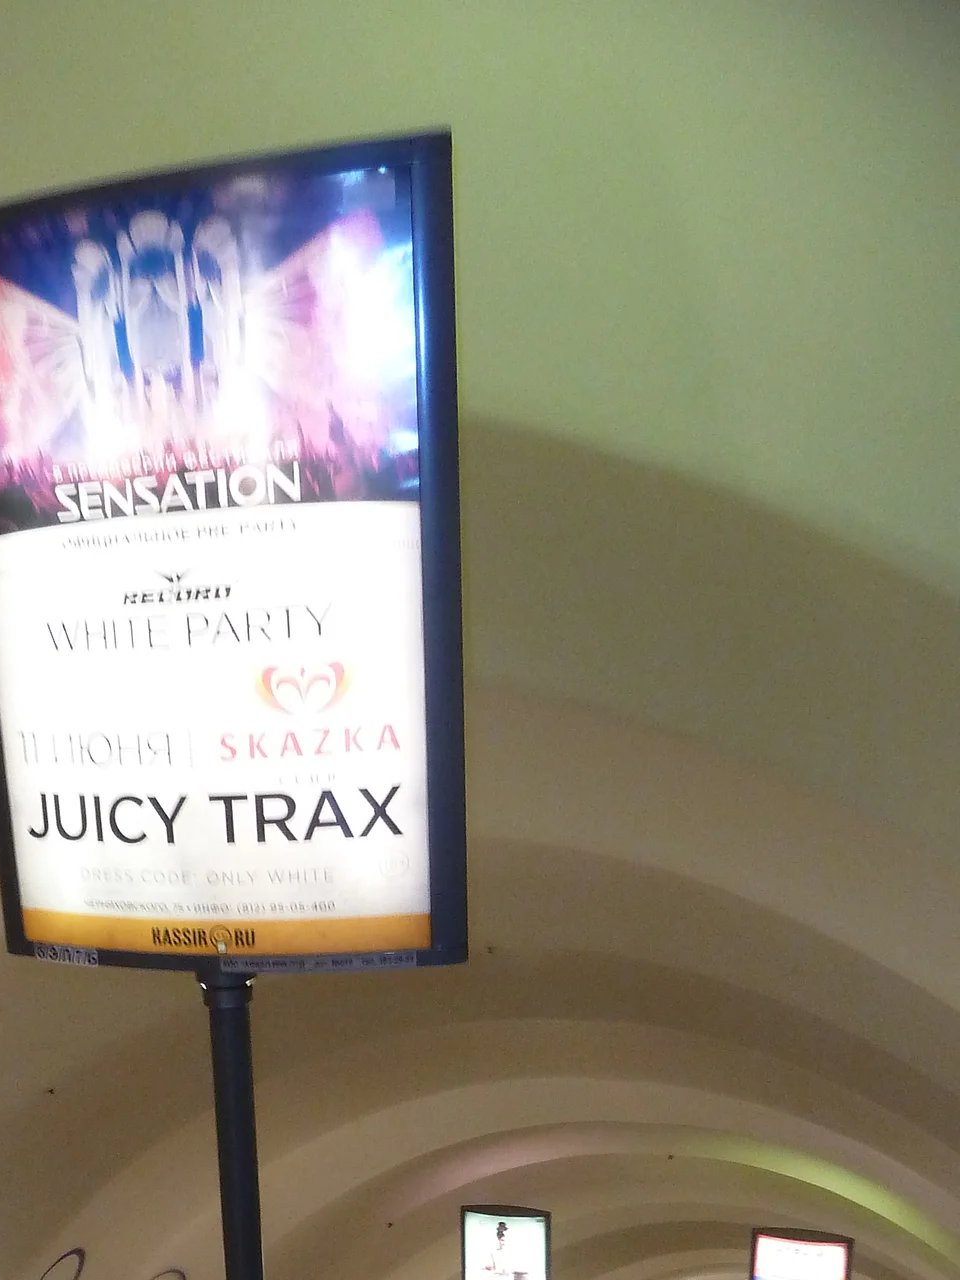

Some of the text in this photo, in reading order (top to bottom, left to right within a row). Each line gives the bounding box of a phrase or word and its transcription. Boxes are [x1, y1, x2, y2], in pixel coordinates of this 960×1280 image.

[53, 461, 301, 524] SENSATION
[46, 603, 333, 651] WHITE PARTY
[220, 724, 402, 763] SKAZKA
[28, 784, 404, 845] JUICY TRAX
[206, 868, 256, 887] ONLY
[267, 867, 336, 884] WHITE
[152, 927, 208, 947] KASSIR
